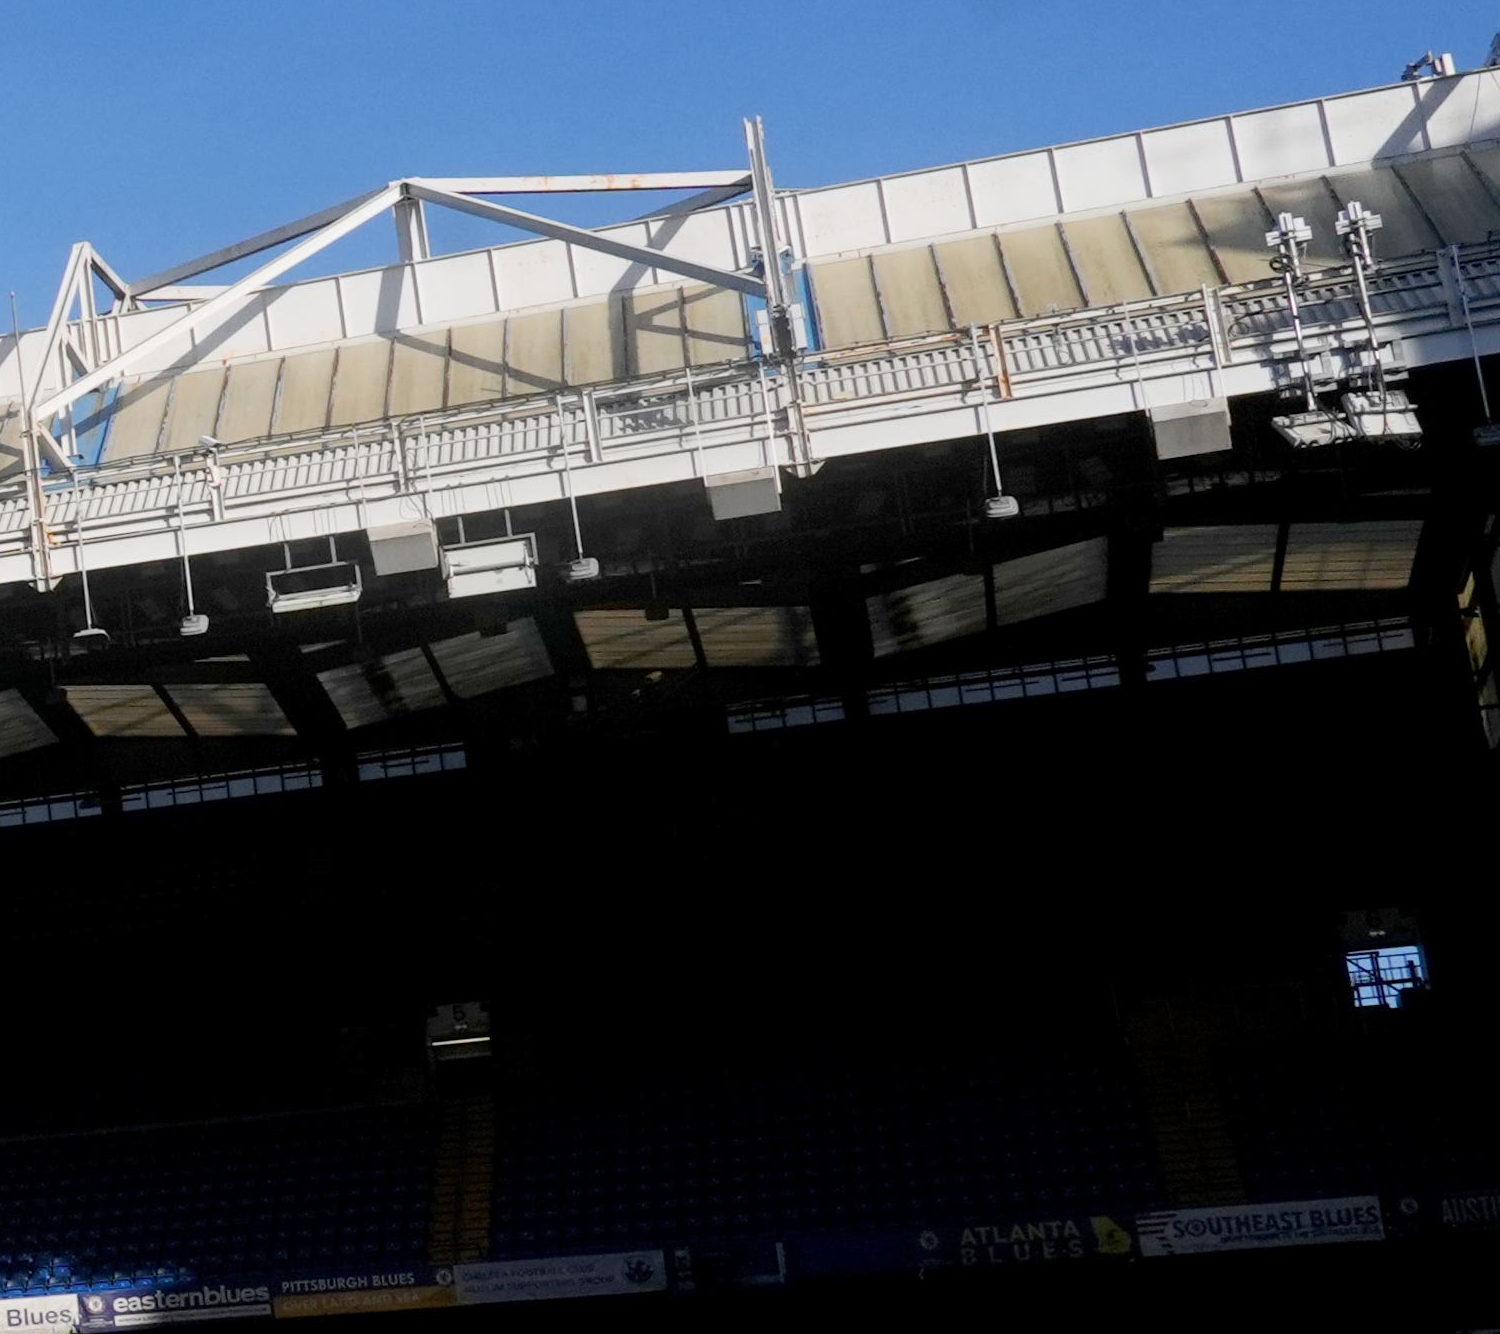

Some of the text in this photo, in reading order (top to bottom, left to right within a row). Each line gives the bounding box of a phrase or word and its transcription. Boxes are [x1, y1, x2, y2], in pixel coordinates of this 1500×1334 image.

[959, 1220, 1082, 1245] ATLANTA
[1173, 1212, 1304, 1238] SOUTHEAST
[1309, 1206, 1379, 1227] BLUES
[959, 1239, 1084, 1266] BLUES
[282, 1272, 415, 1292] PITTSBURGH BLUES
[112, 1285, 270, 1313] easternblues
[363, 1294, 392, 1306] AND
[396, 1290, 421, 1303] SEA
[7, 1306, 72, 1327] Blues
